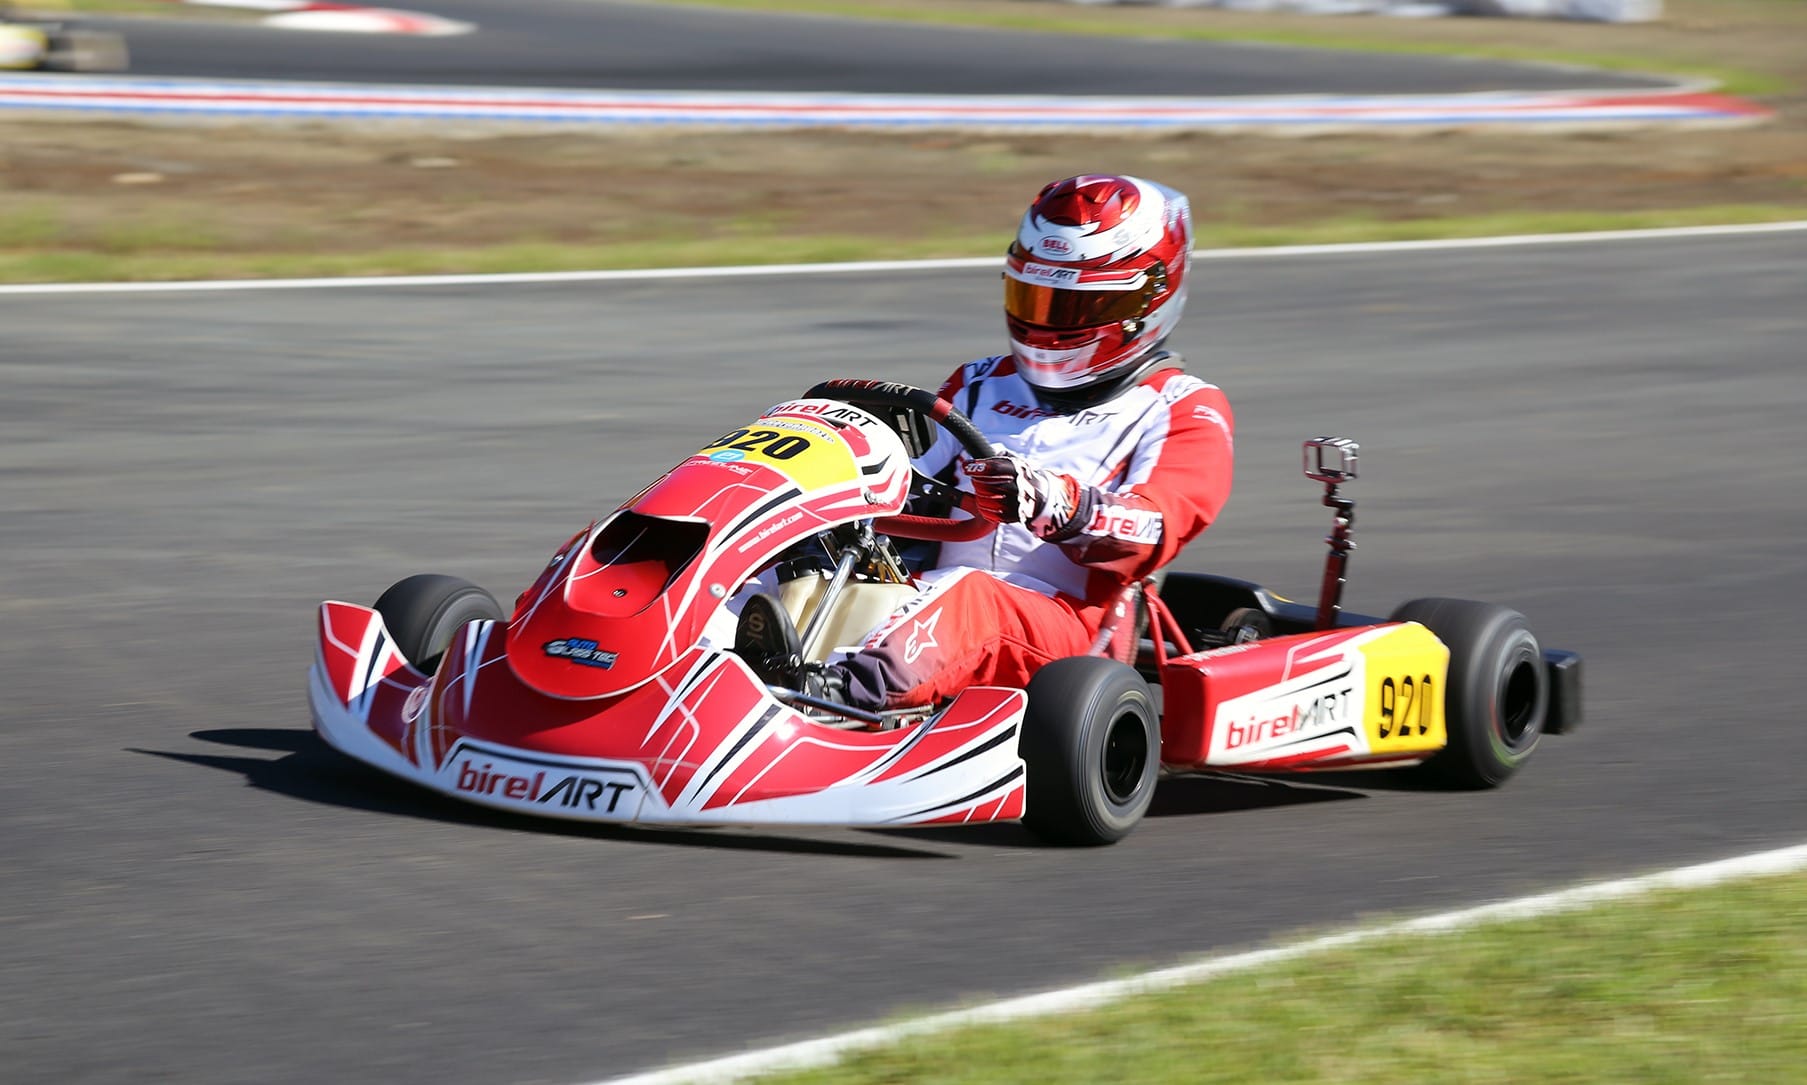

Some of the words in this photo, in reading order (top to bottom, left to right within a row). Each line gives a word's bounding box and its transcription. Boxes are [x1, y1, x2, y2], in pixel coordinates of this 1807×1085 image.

[1043, 239, 1070, 252] BELL
[1225, 688, 1353, 750] birelART
[1379, 674, 1433, 739] 920
[457, 759, 635, 813] birelART
